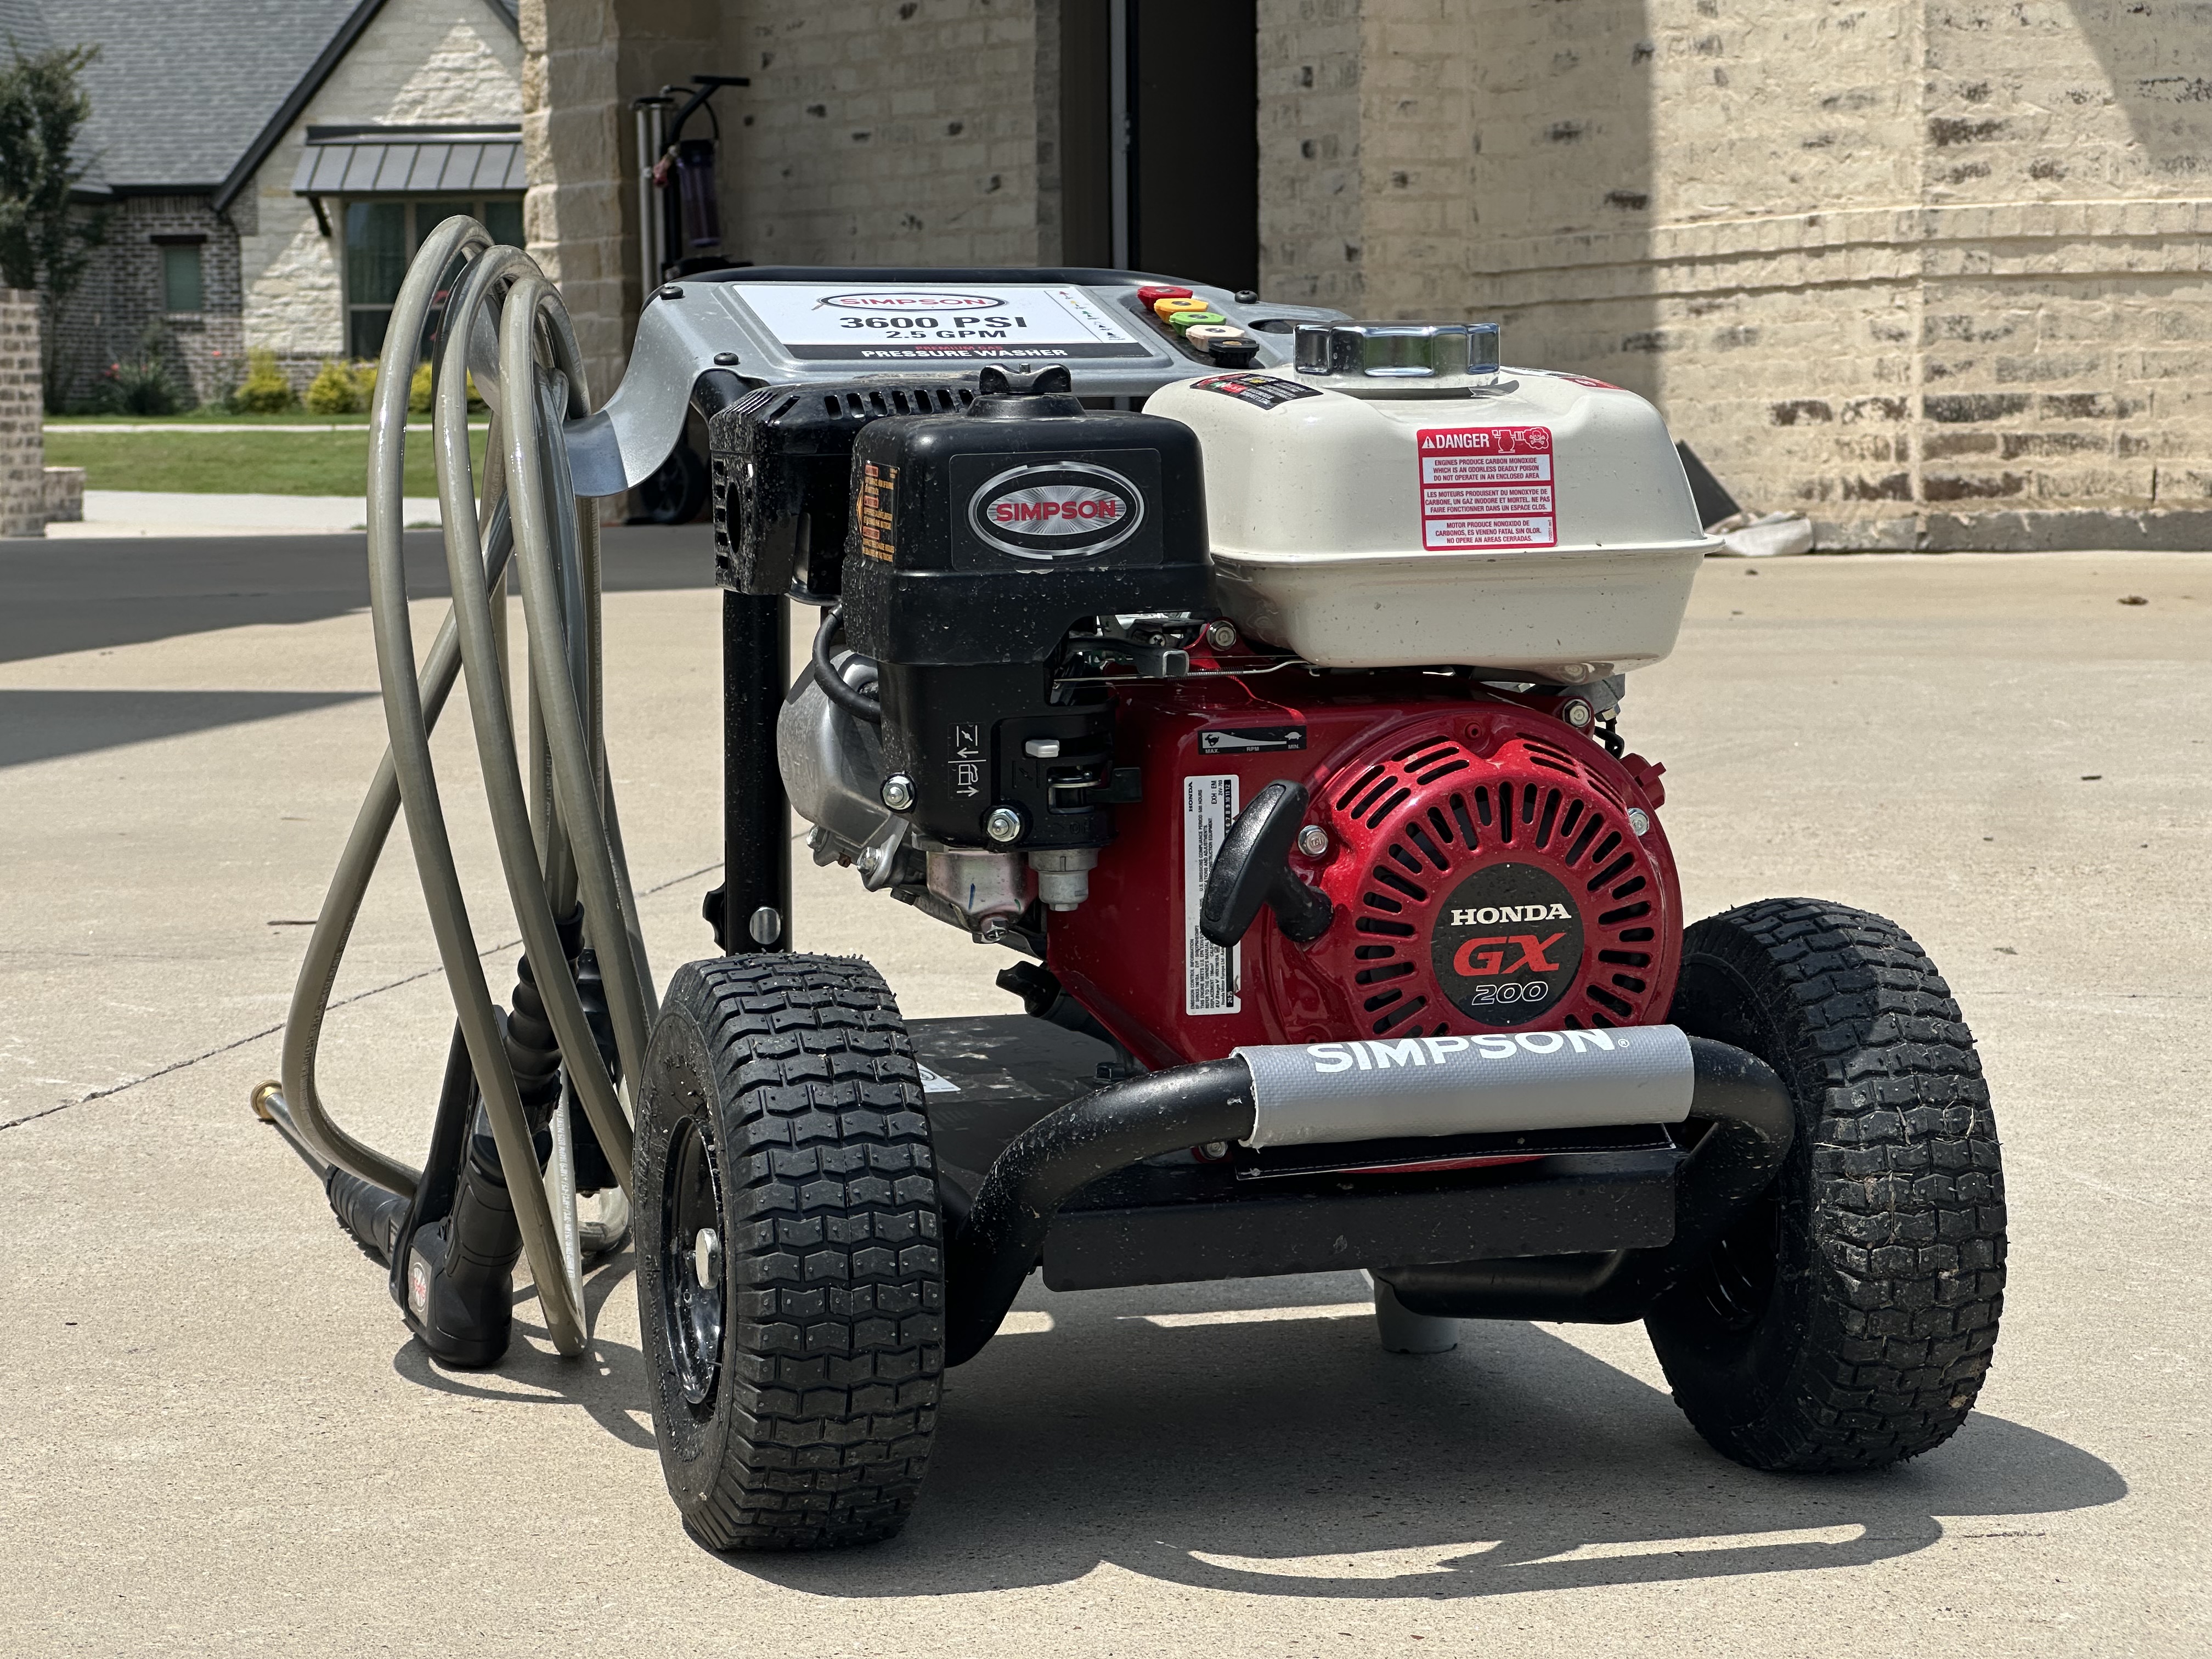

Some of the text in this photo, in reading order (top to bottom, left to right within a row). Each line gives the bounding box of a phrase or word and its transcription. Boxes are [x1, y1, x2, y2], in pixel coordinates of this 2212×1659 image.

[839, 317, 1027, 328] 3600 PSI
[1435, 433, 1490, 449] DANGER
[996, 500, 1116, 522] SIMPSON
[1451, 903, 1572, 926] HONDA
[1453, 932, 1567, 977] GX
[1471, 980, 1549, 1006] 200
[1306, 1028, 1615, 1073] SIMPSON
